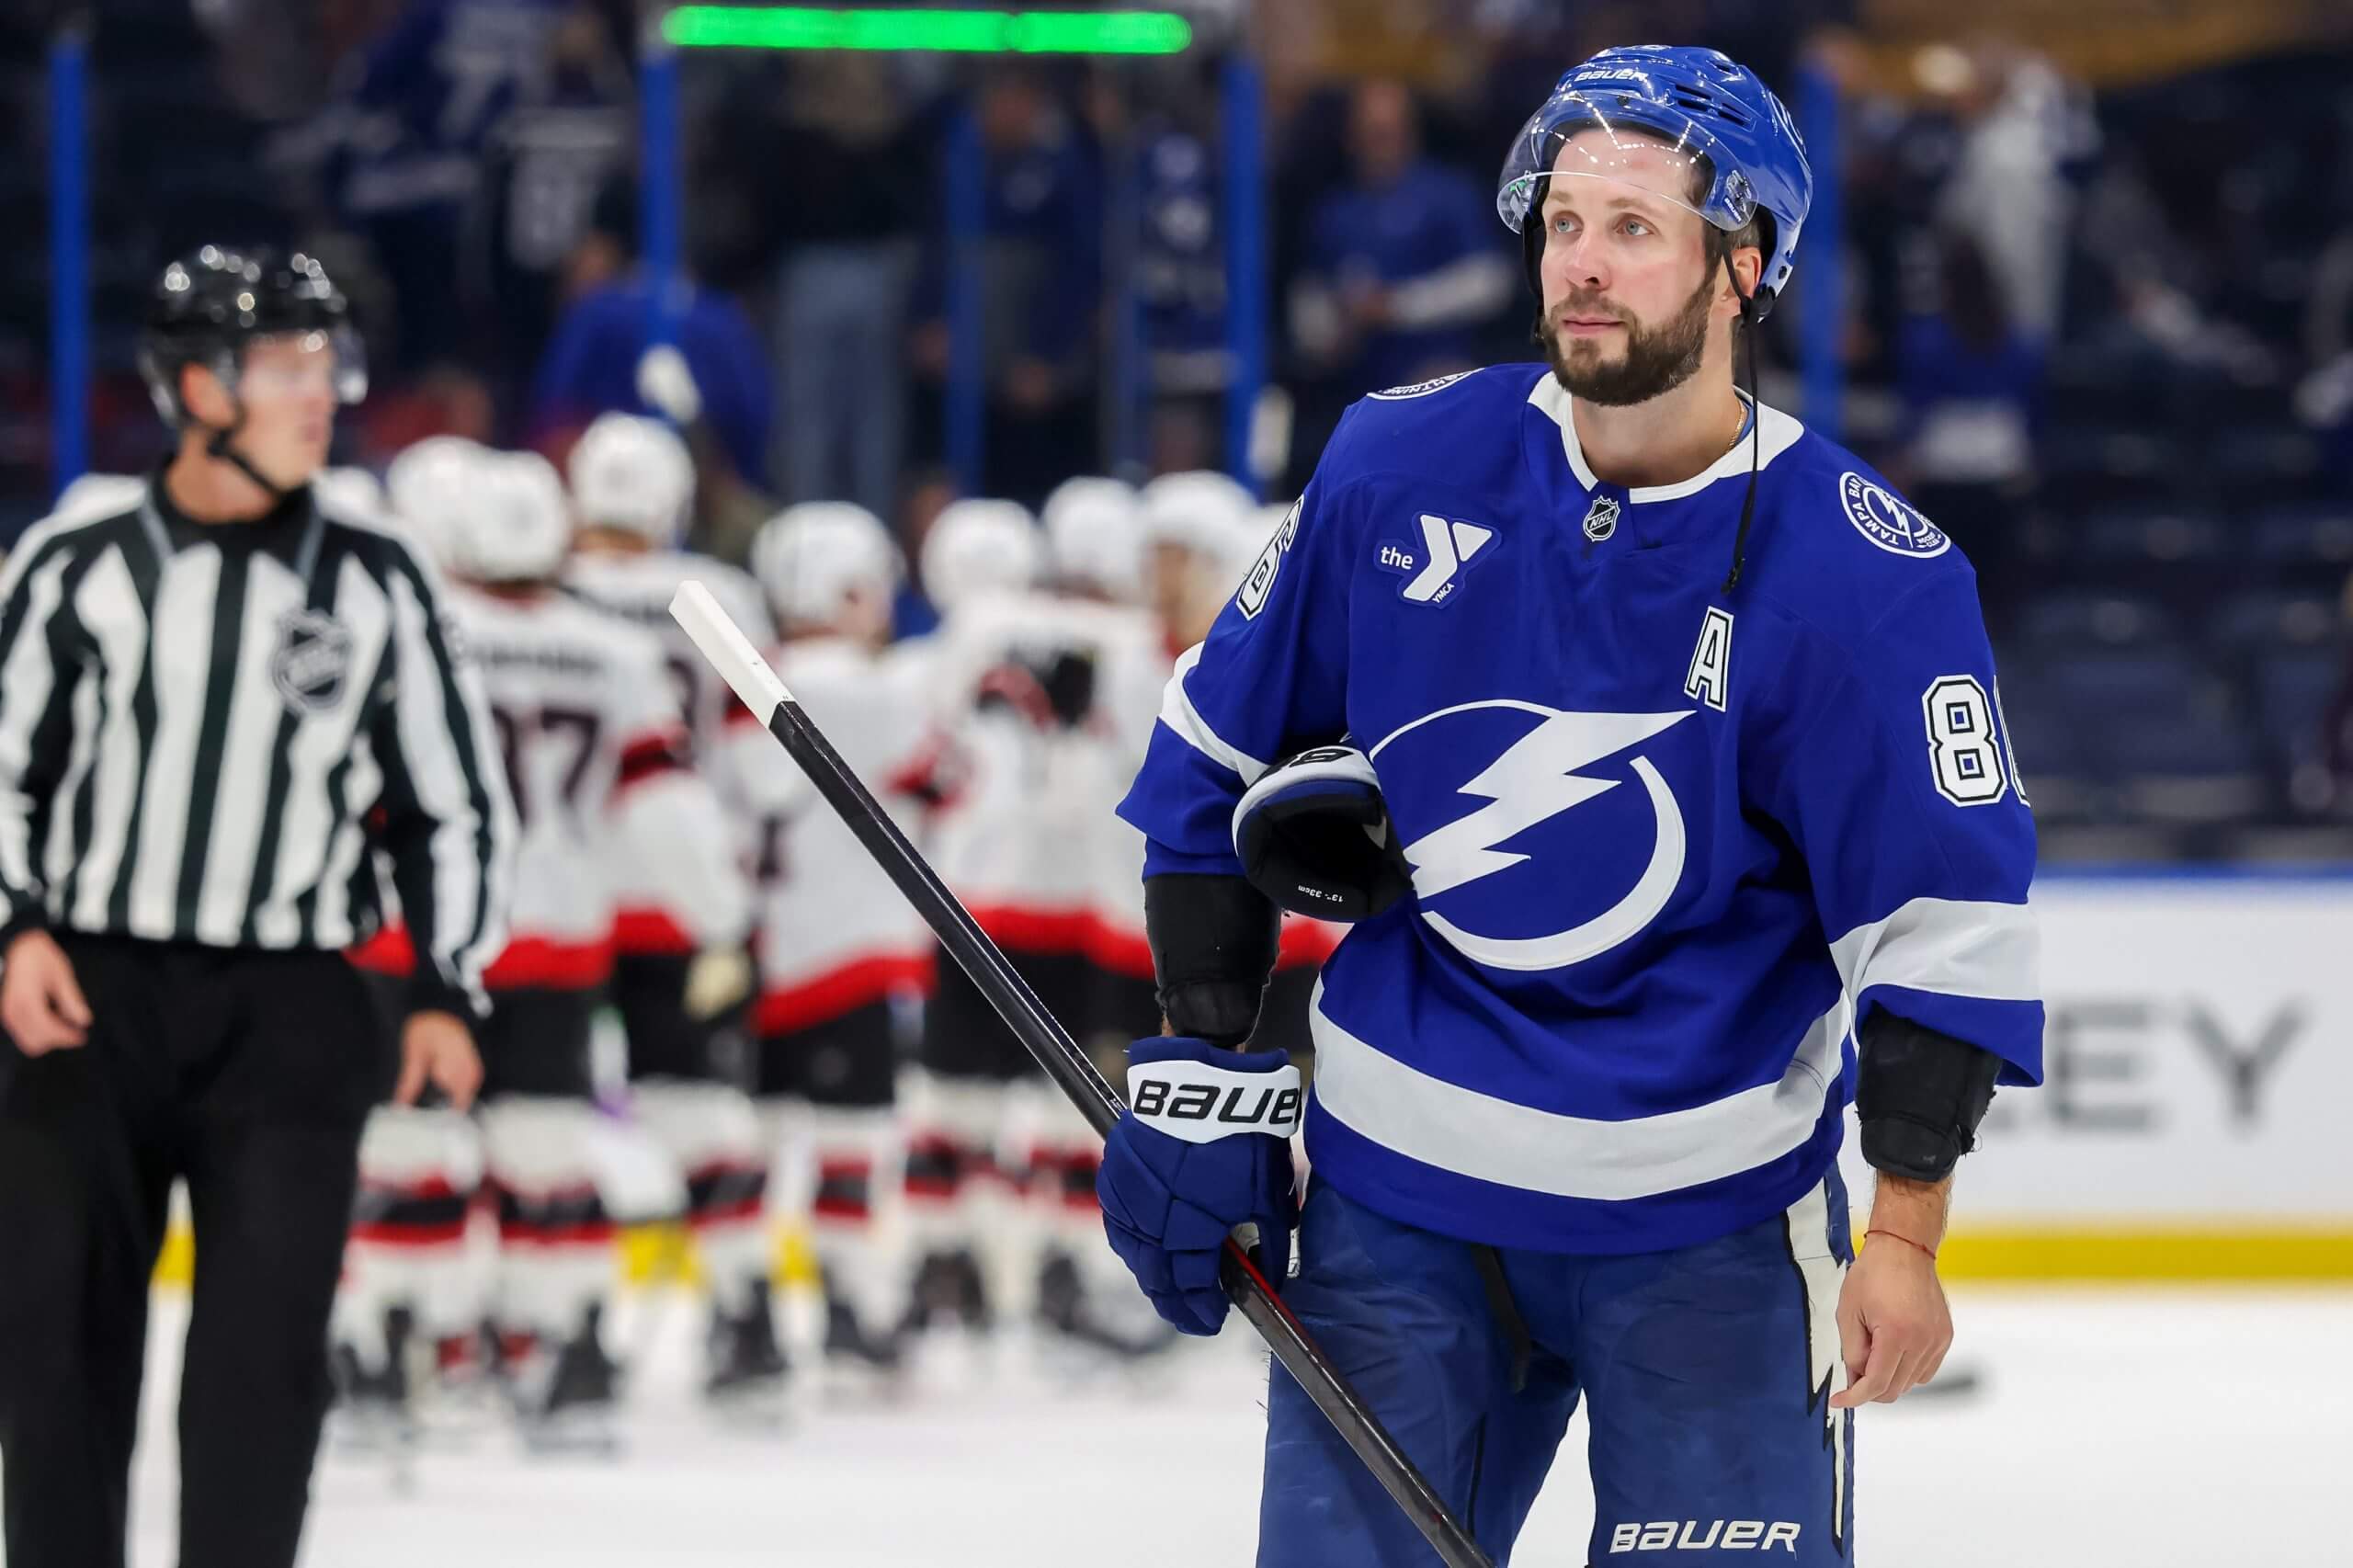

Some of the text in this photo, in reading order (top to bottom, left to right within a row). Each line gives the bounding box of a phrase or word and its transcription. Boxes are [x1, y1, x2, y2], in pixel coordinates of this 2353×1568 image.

[1848, 477, 1863, 499] BAY
[1589, 511, 1612, 528] NHL
[1852, 502, 1900, 545] TAMPA
[1381, 546, 1414, 570] the
[1432, 583, 1455, 604] YMCA
[1684, 605, 1734, 713] A
[1922, 674, 2030, 808] 8
[1297, 884, 1323, 898] 33cm
[1133, 1079, 1302, 1125] BAUE
[1609, 1519, 1801, 1553] BAUER
